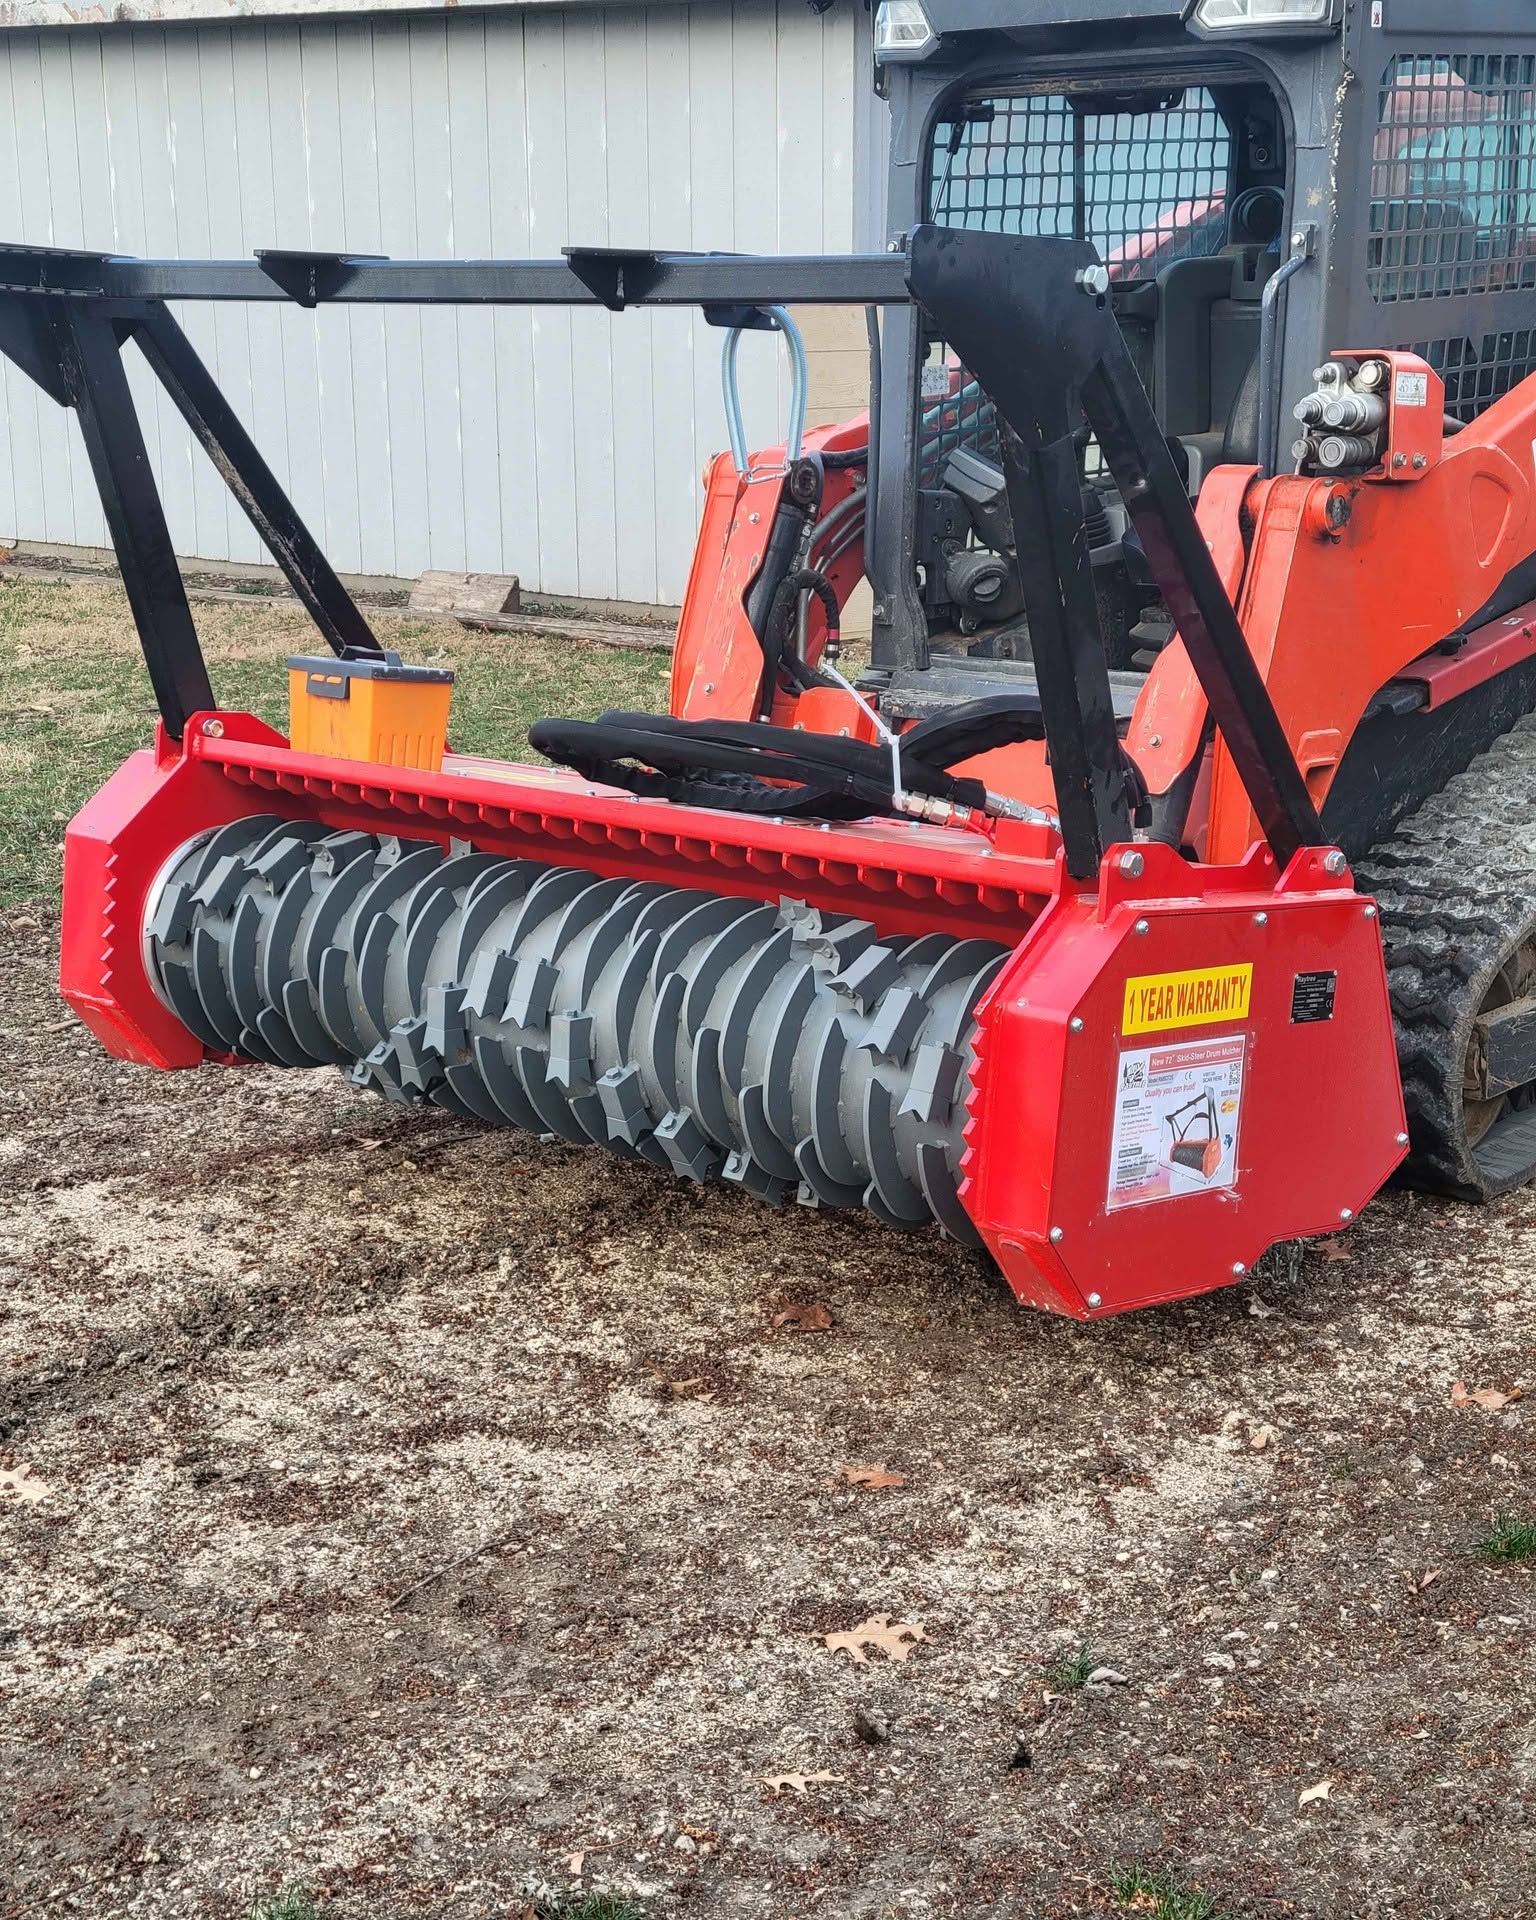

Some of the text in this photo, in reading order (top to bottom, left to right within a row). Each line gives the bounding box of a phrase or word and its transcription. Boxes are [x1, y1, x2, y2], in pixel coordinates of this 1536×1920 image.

[1130, 975, 1247, 1024] 1 YEAR WARRANTY
[1151, 1056, 1164, 1067] New
[1177, 1051, 1205, 1063] Skid-Steer
[1206, 1049, 1221, 1059] Drum
[1145, 1087, 1162, 1098] Quality
[1162, 1087, 1172, 1096] you
[1172, 1085, 1182, 1093] can
